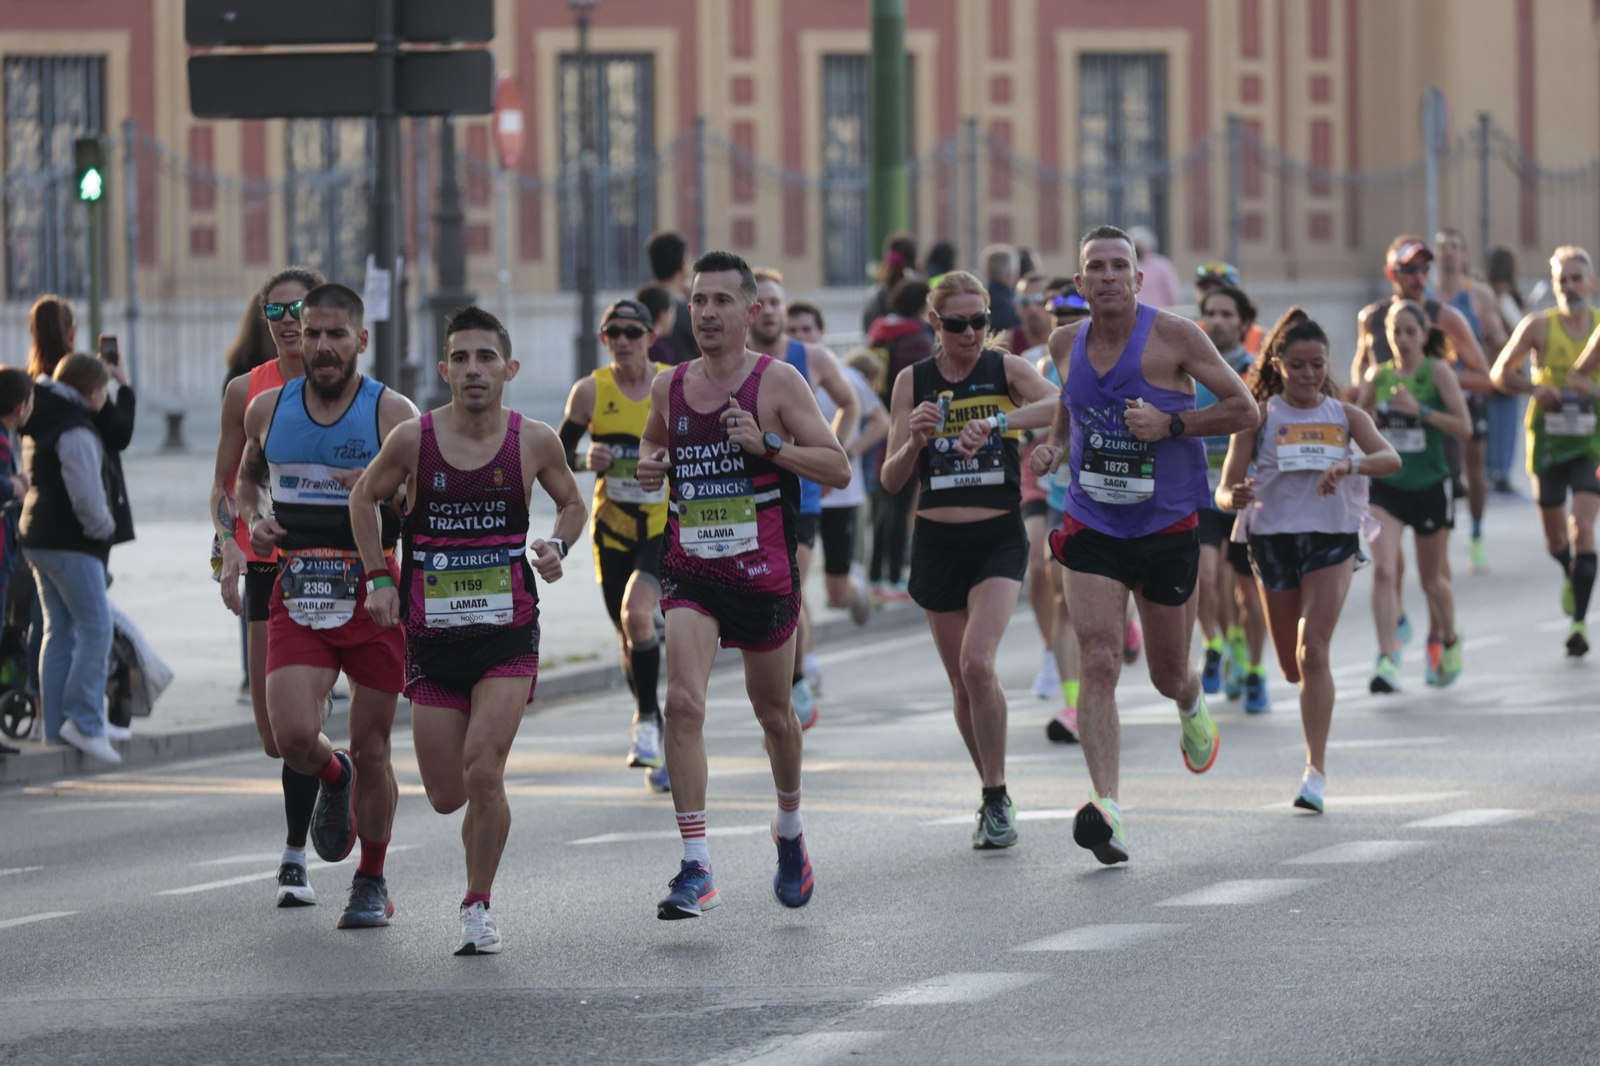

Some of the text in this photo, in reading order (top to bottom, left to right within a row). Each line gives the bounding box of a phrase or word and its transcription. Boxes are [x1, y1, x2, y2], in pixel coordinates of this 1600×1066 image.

[946, 404, 1000, 423] CHESTER
[676, 440, 741, 461] OCTAVUS
[1104, 439, 1147, 451] ZURICH
[1300, 446, 1325, 454] GRACE
[333, 445, 372, 460] Team
[675, 455, 745, 478] TRIATLÓN
[954, 458, 979, 472] 3158
[1104, 460, 1129, 474] 1873
[301, 477, 349, 492] TrailRun
[954, 476, 982, 486] SARAH
[1103, 478, 1128, 489] SAGIV
[697, 482, 744, 496] ZURICH
[429, 500, 507, 515] OCTAVUS
[700, 508, 728, 521] 1212
[428, 513, 507, 530] TRIATLÓN
[697, 528, 735, 539] CALAVIA
[306, 560, 351, 571] ZURICH
[451, 552, 500, 567] ZURICH
[303, 581, 332, 595] 2350
[453, 579, 483, 592] 1159
[450, 598, 488, 610] LAMATA
